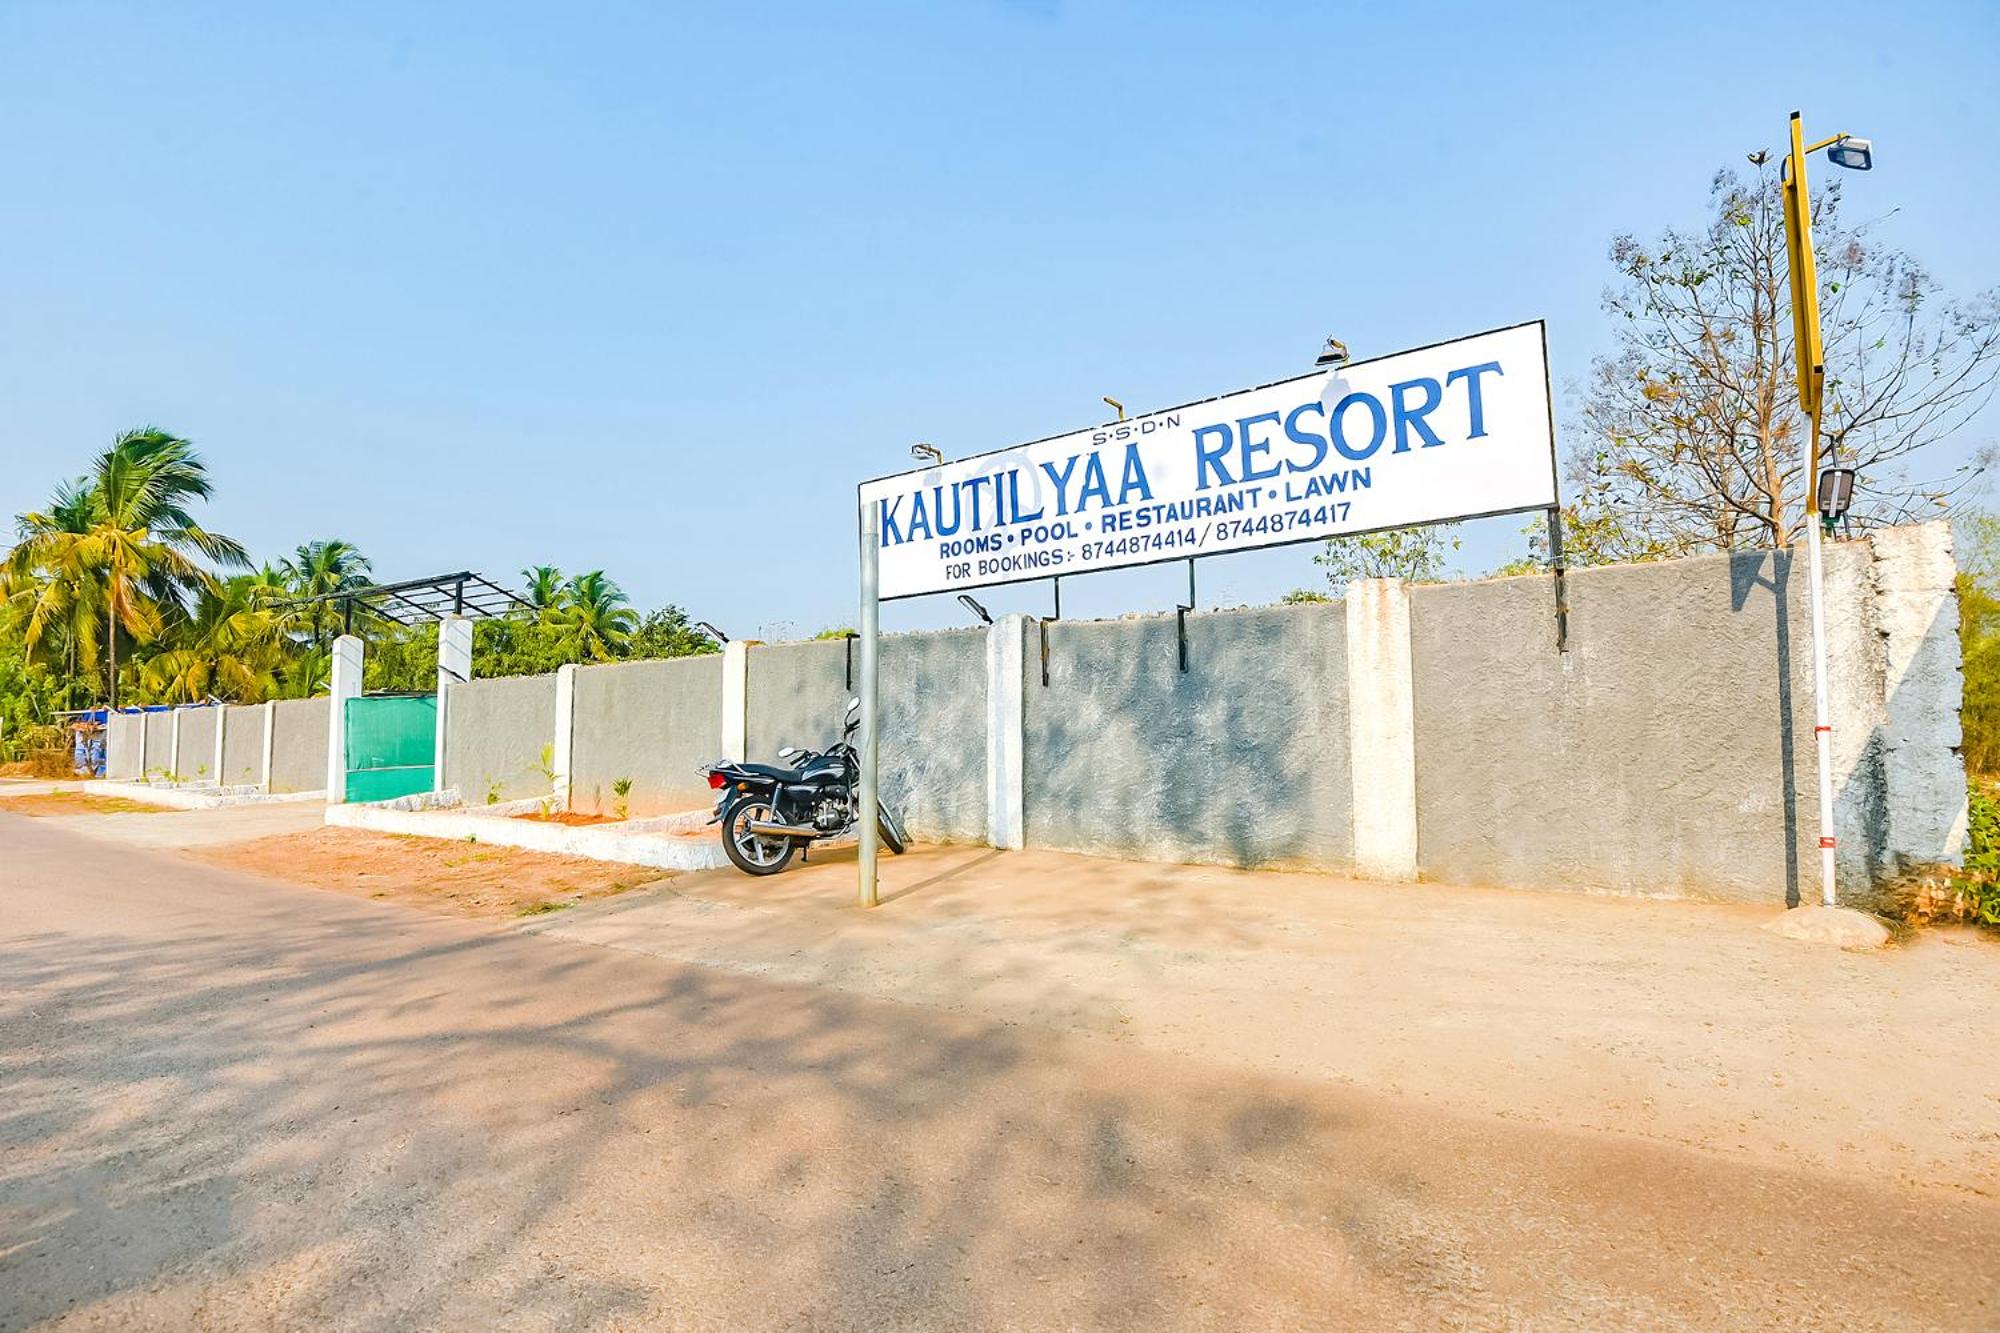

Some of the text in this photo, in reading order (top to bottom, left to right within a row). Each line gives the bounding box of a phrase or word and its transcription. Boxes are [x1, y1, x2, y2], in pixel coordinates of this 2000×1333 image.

[880, 361, 1504, 547] KAUTILYAA RESORT
[940, 467, 1372, 559] ROOMS POOL RESTAURANT LAWN
[946, 564, 971, 580] FOR
